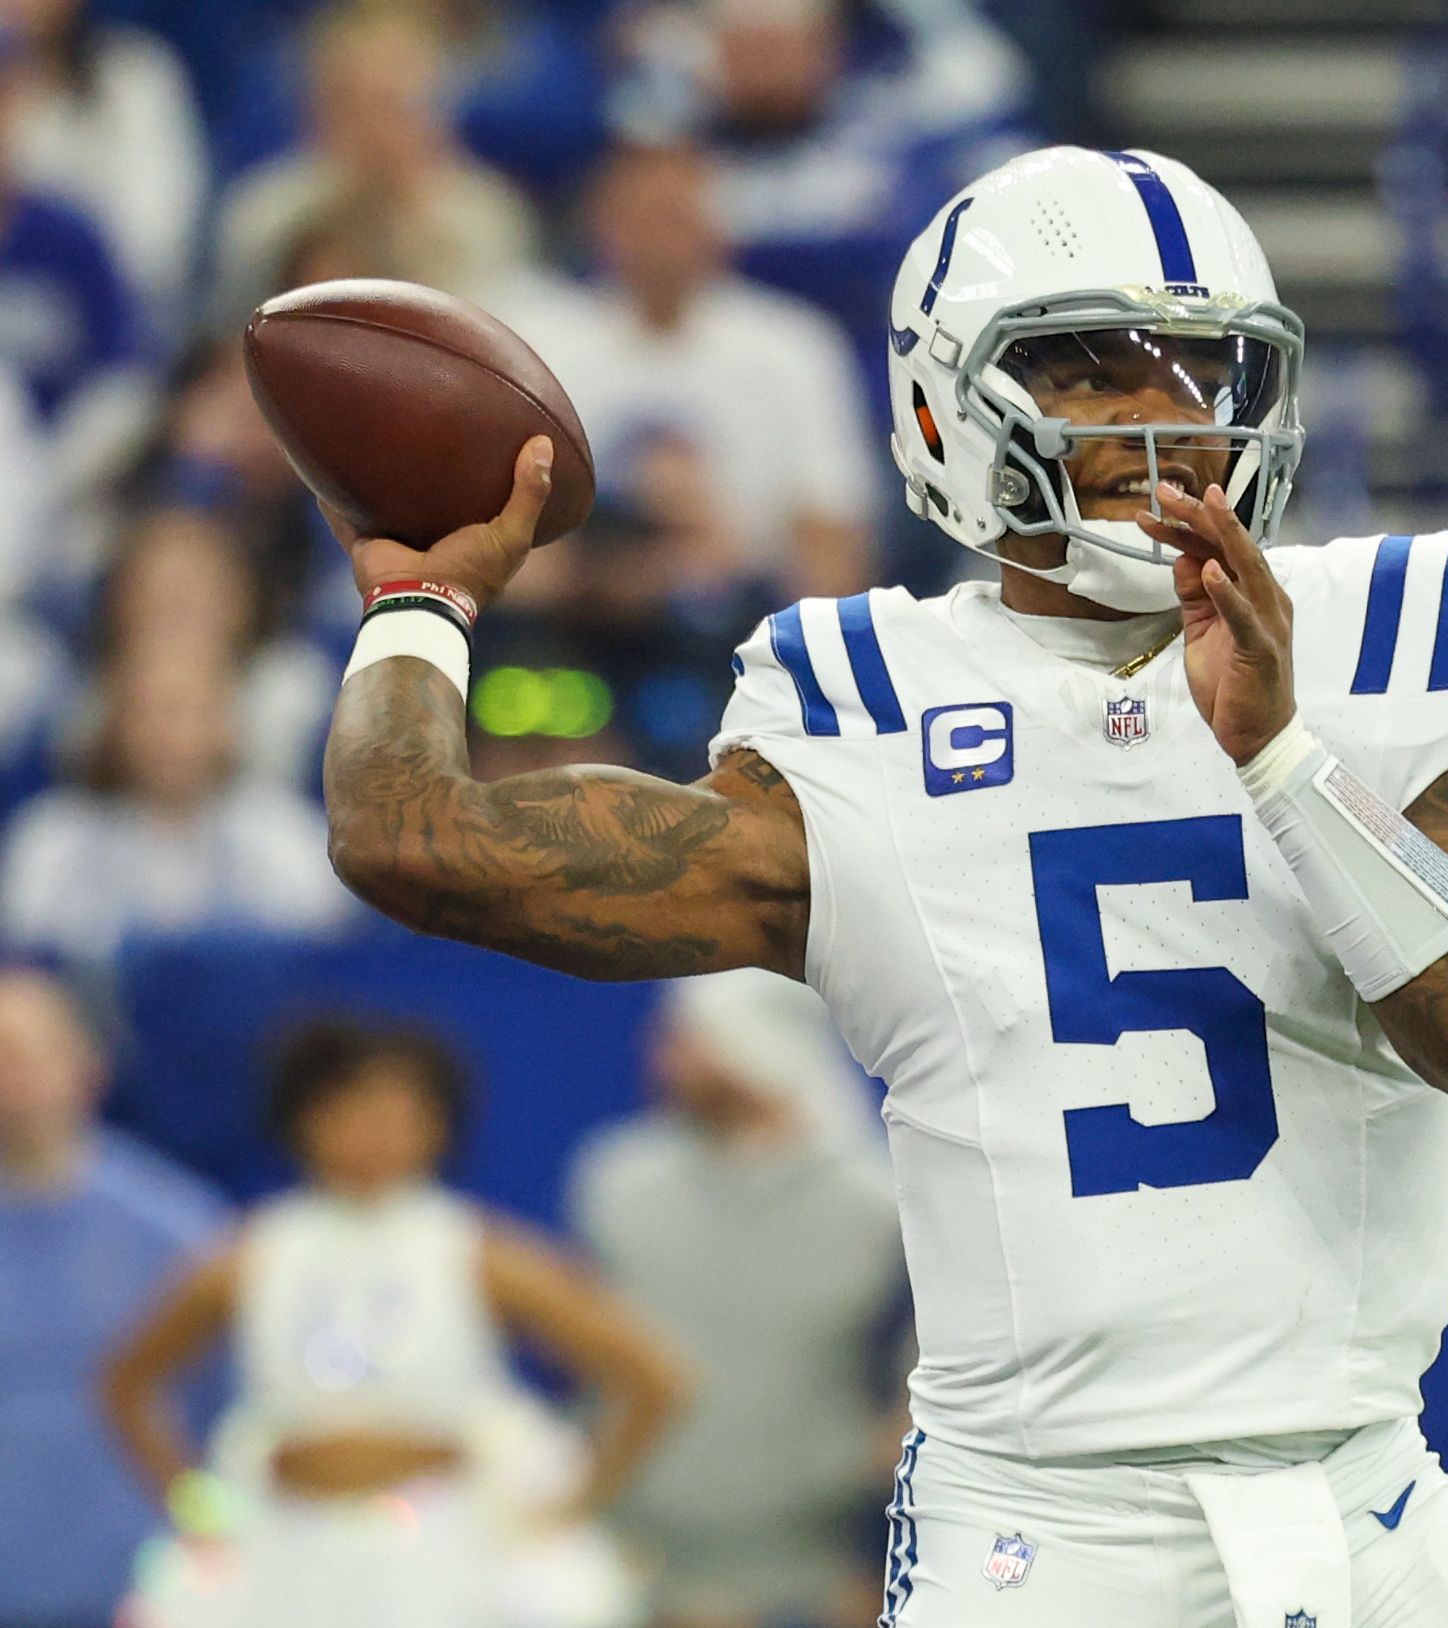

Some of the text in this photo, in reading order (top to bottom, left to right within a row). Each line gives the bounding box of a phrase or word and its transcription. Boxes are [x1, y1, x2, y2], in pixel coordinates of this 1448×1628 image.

[928, 707, 1007, 771] C
[1110, 716, 1143, 738] NFL
[1028, 813, 1280, 1198] 5
[991, 1557, 1021, 1580] NFL
